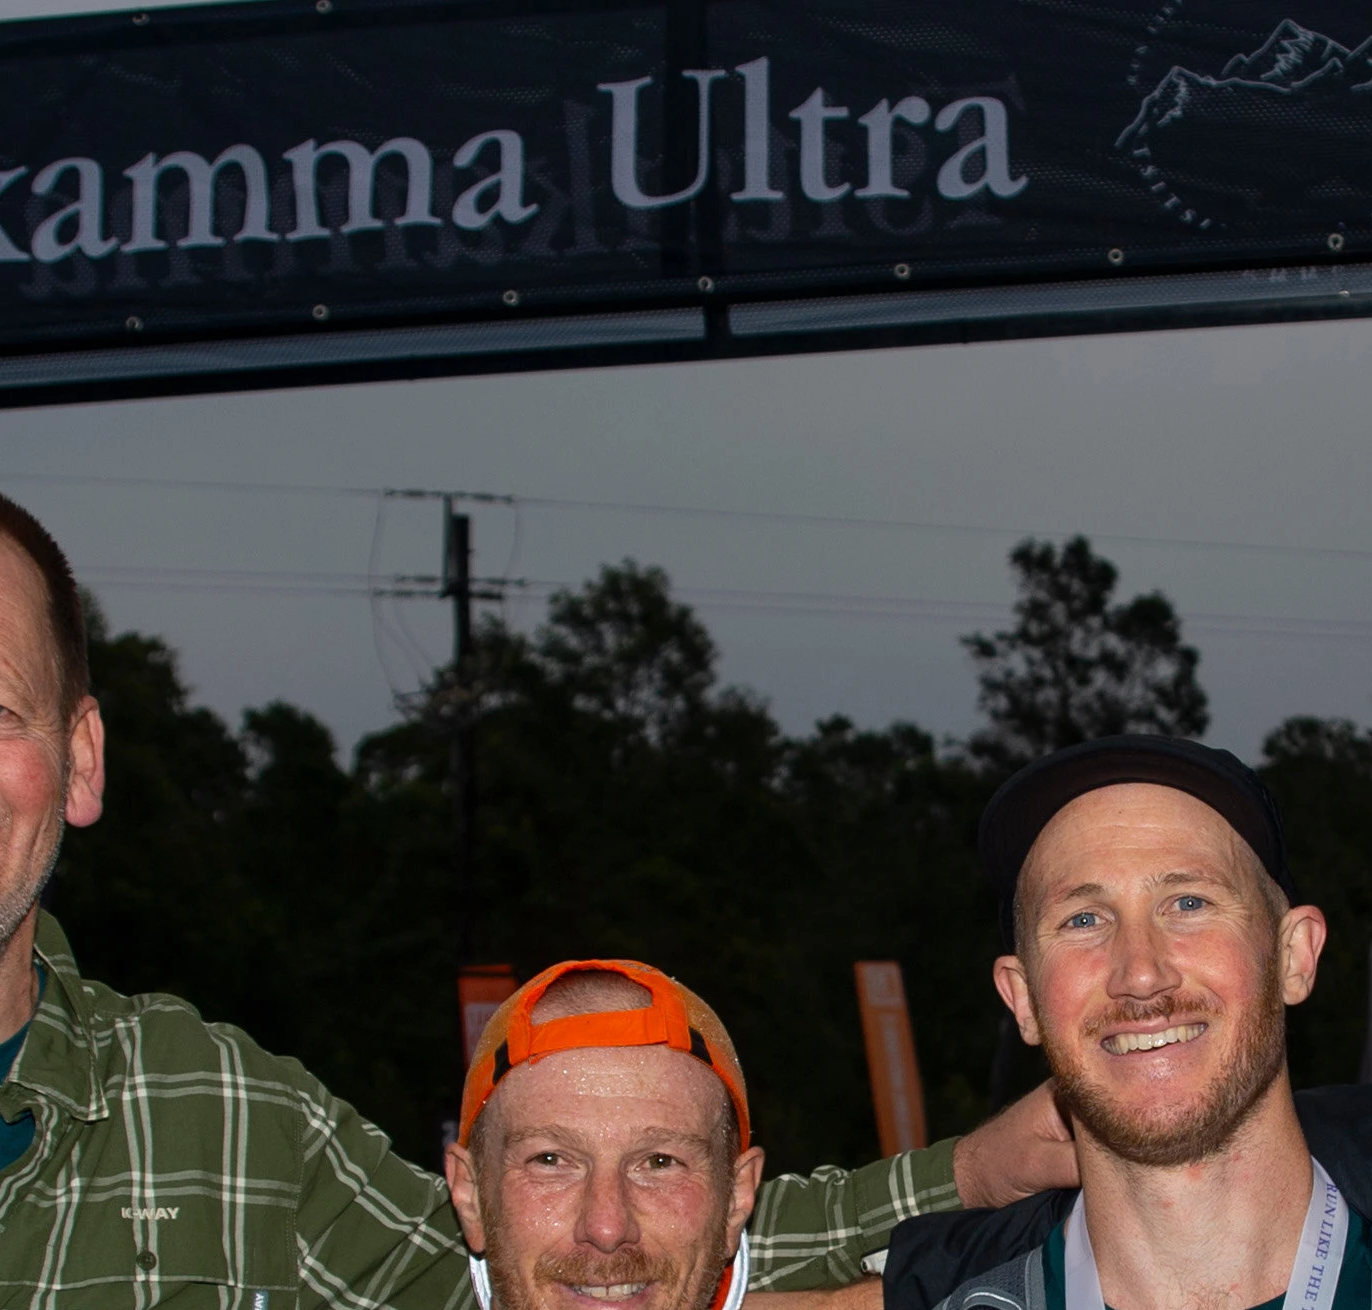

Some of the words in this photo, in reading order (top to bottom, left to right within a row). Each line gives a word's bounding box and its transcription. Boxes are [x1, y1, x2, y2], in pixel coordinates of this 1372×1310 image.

[596, 56, 1029, 211] Ultra
[120, 1206, 181, 1220] K-WAY
[1324, 1182, 1339, 1219] RUN
[1315, 1219, 1333, 1260] LIKE
[1304, 1264, 1325, 1303] THE
